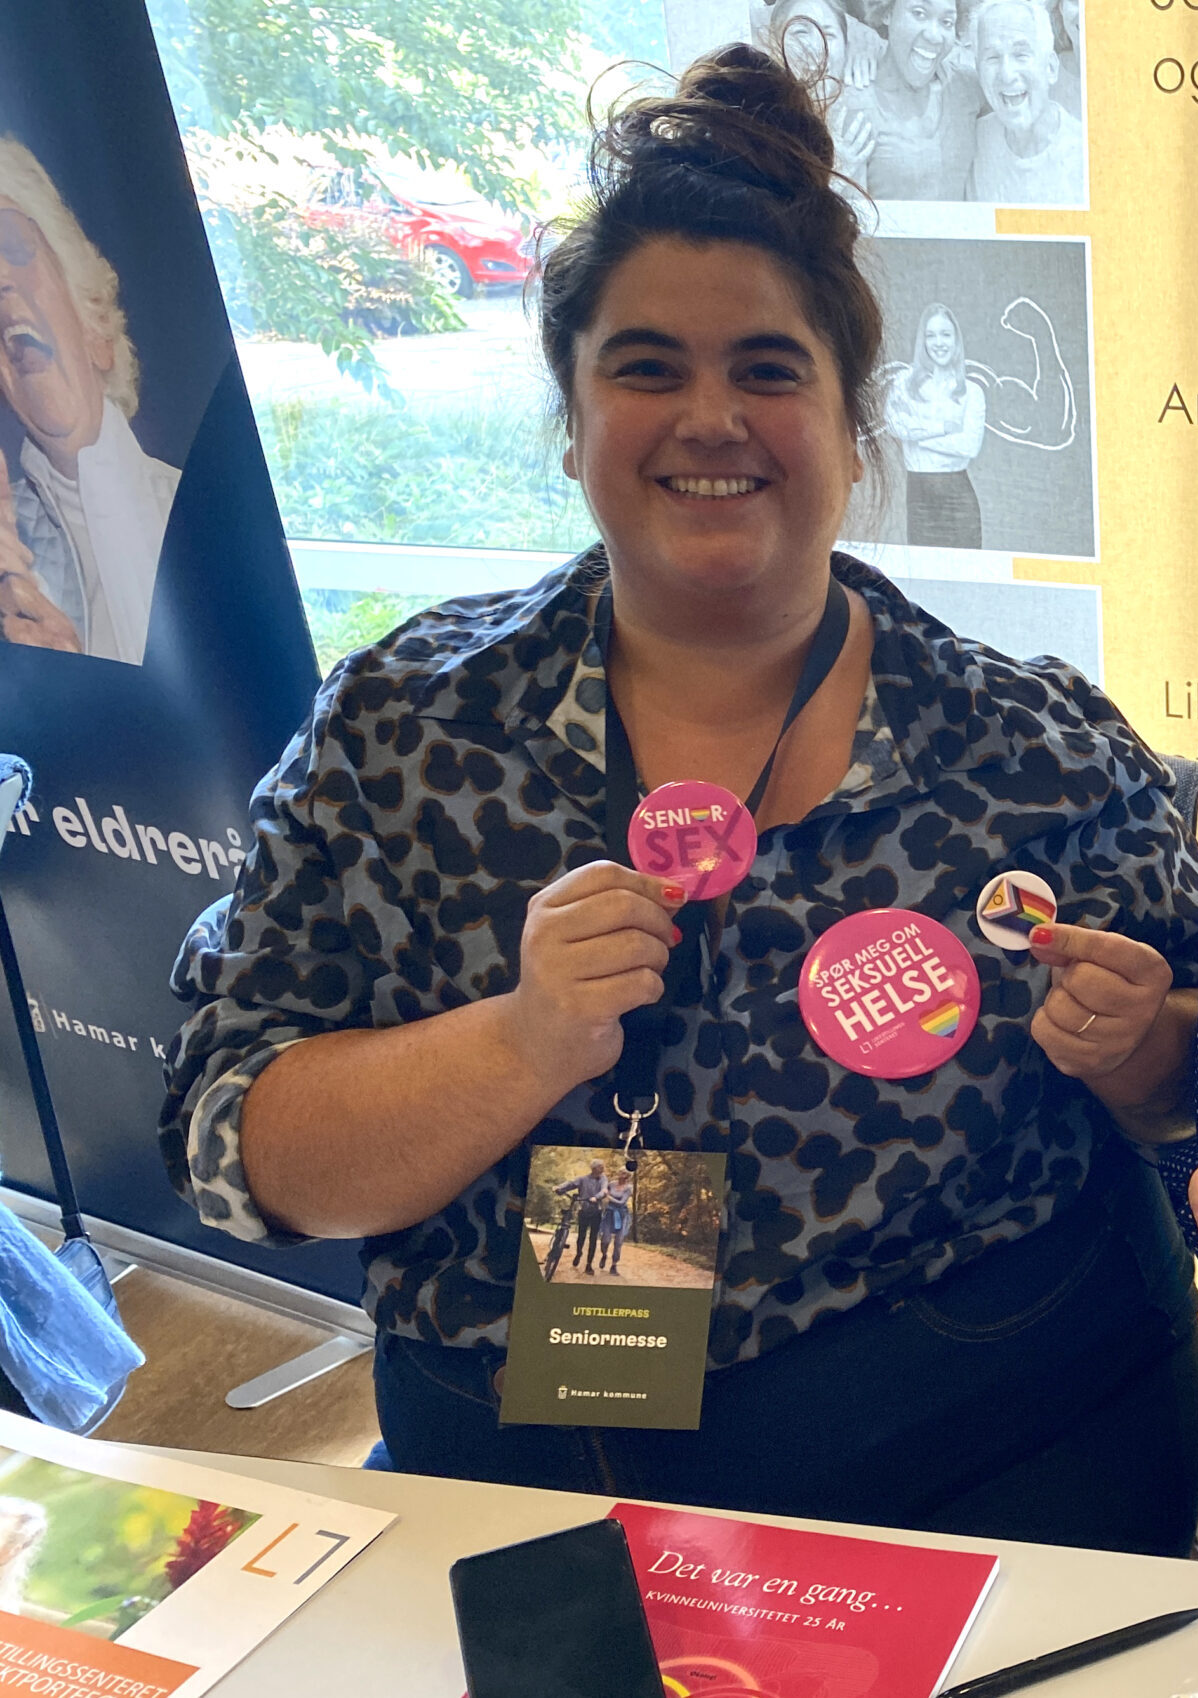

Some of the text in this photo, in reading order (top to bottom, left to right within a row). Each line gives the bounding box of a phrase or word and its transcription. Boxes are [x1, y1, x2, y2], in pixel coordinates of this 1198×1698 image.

[814, 923, 921, 988] SPØR MEG OM
[821, 937, 934, 1007] SEKSUELL
[834, 956, 955, 1041] HELSE
[52, 1009, 137, 1051] Hamar
[573, 1306, 650, 1318] UTSTILLERPASS
[549, 1327, 667, 1348] Seniormesse
[571, 1388, 647, 1400] Hamar kommune
[648, 1550, 705, 1580] Det
[711, 1568, 760, 1589] var
[762, 1577, 798, 1596] en
[645, 1590, 846, 1632] KVINNEUNIVERSITETET 25 ÅR
[0, 1640, 168, 1698] TILLINGSSENTERET
